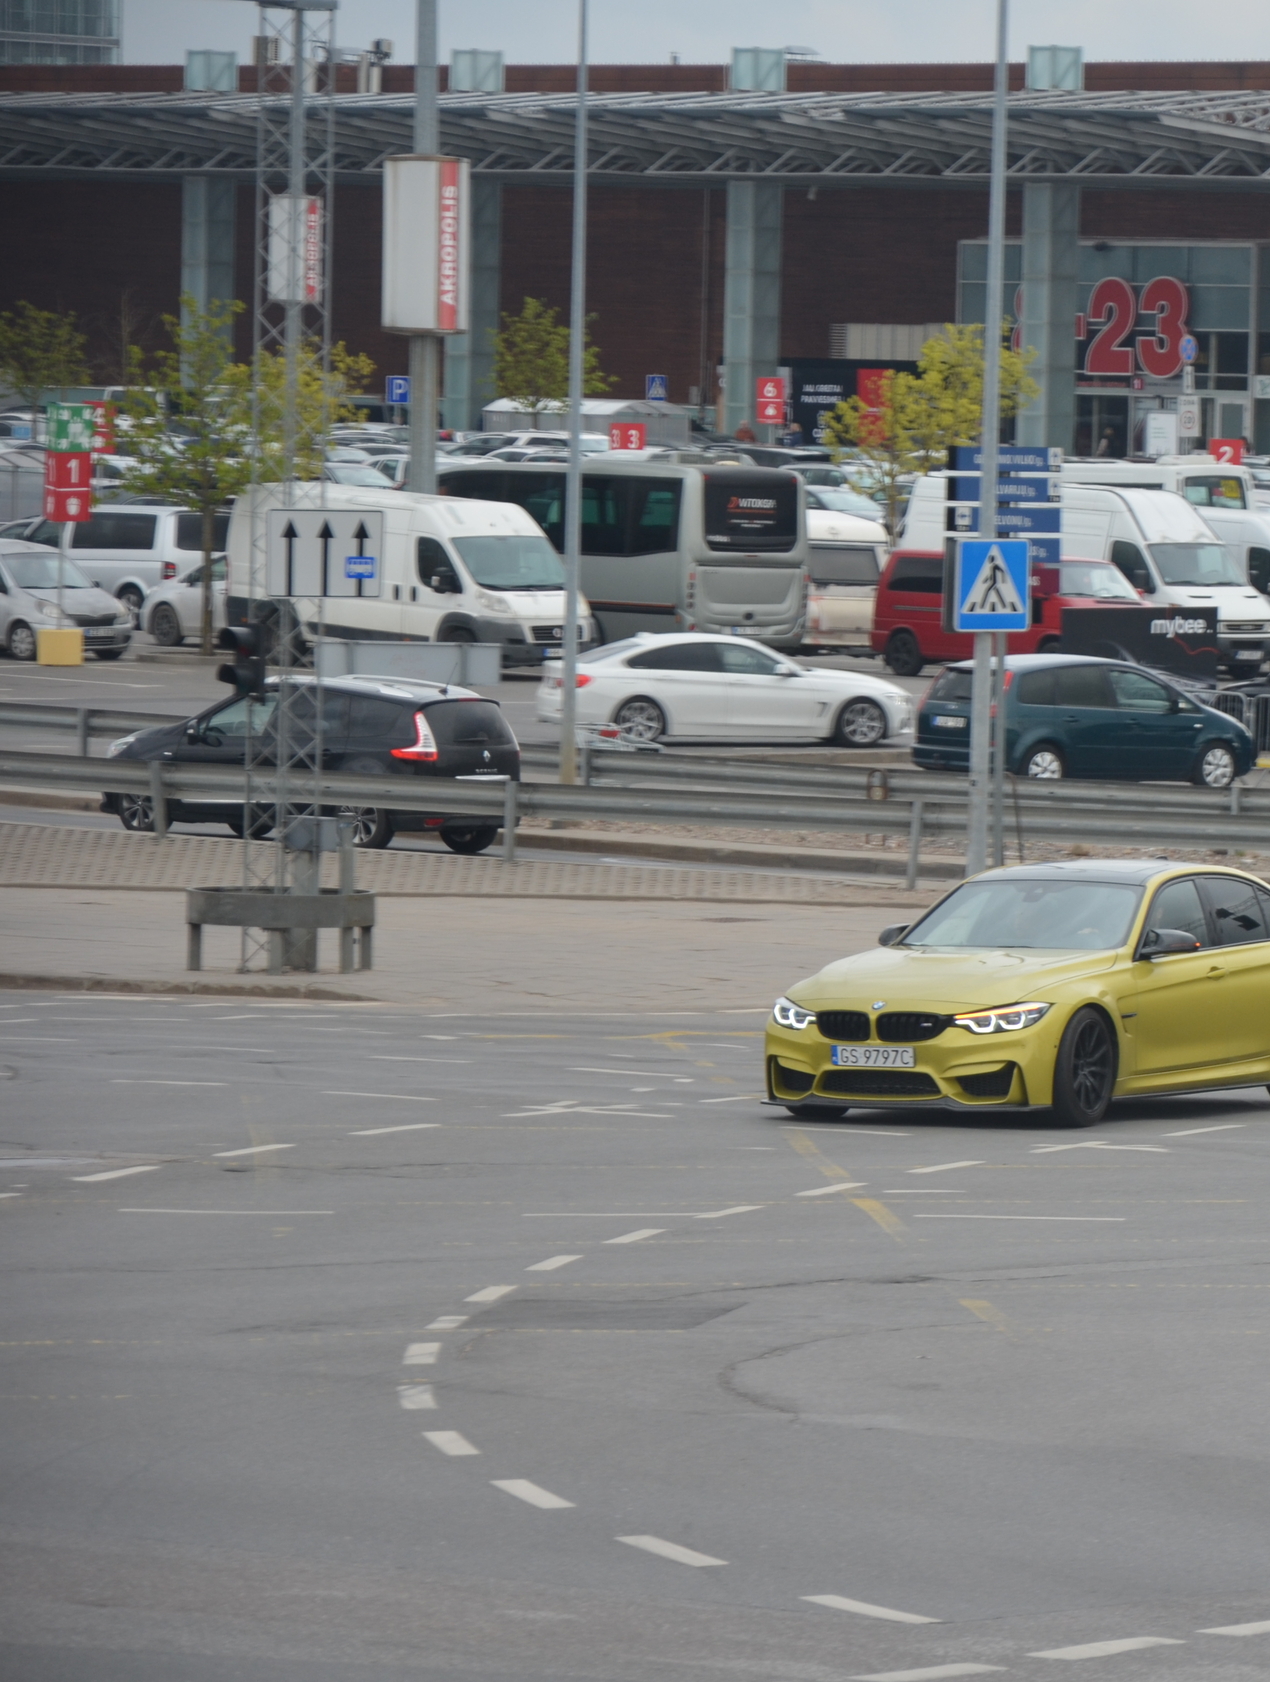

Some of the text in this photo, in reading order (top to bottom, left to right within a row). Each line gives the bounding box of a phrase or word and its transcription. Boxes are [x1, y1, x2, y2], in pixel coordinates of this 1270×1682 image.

[439, 186, 458, 306] AKROPOLIS
[392, 379, 408, 400] P
[763, 382, 777, 397] 6
[1218, 446, 1234, 465] 2
[67, 459, 80, 484] 1
[840, 1048, 910, 1065] GS 9797C
